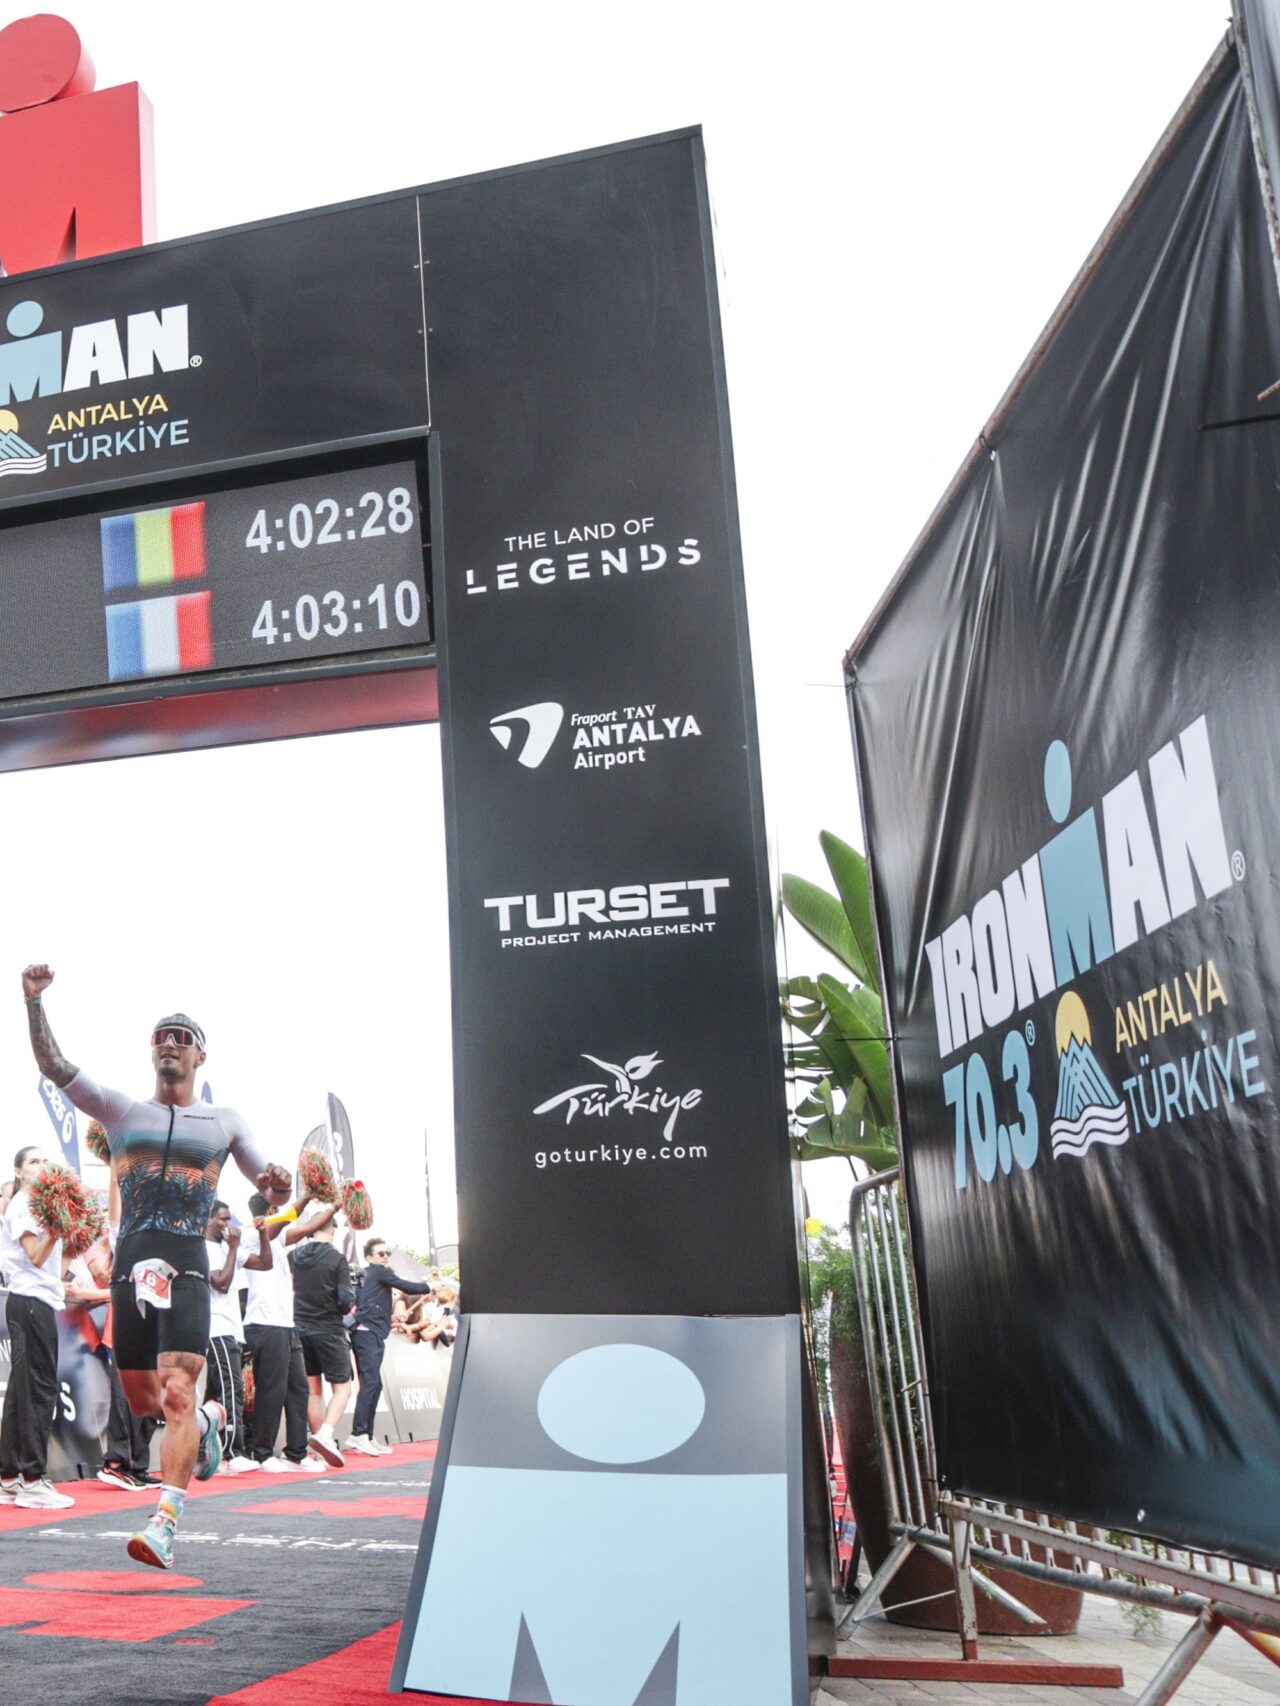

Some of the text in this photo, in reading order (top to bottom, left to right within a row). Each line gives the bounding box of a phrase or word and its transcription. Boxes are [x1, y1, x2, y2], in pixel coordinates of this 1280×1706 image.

[47, 393, 169, 434] ANTALYA
[47, 419, 190, 468] TÜRKİYE
[245, 487, 415, 554] 4:02:28
[504, 517, 655, 552] THE LAND OF
[466, 538, 701, 595] LEGENDS
[251, 579, 421, 645] 4:03:10
[571, 704, 656, 727] Fraport TAV
[572, 715, 702, 750] ANTALYA
[574, 747, 646, 770] Airport
[483, 878, 730, 932] TURSET
[925, 714, 1234, 1059] IRONMAN
[501, 922, 716, 948] PROJECT MANAGEMENT
[1114, 960, 1229, 1053] ANTALYA
[1122, 1029, 1266, 1133] TÜRKİYE
[533, 1083, 703, 1142] Türkiye
[942, 1030, 1040, 1190] 70.3
[535, 1144, 708, 1168] goturkiye.com
[399, 1387, 442, 1411] HOSPITAL
